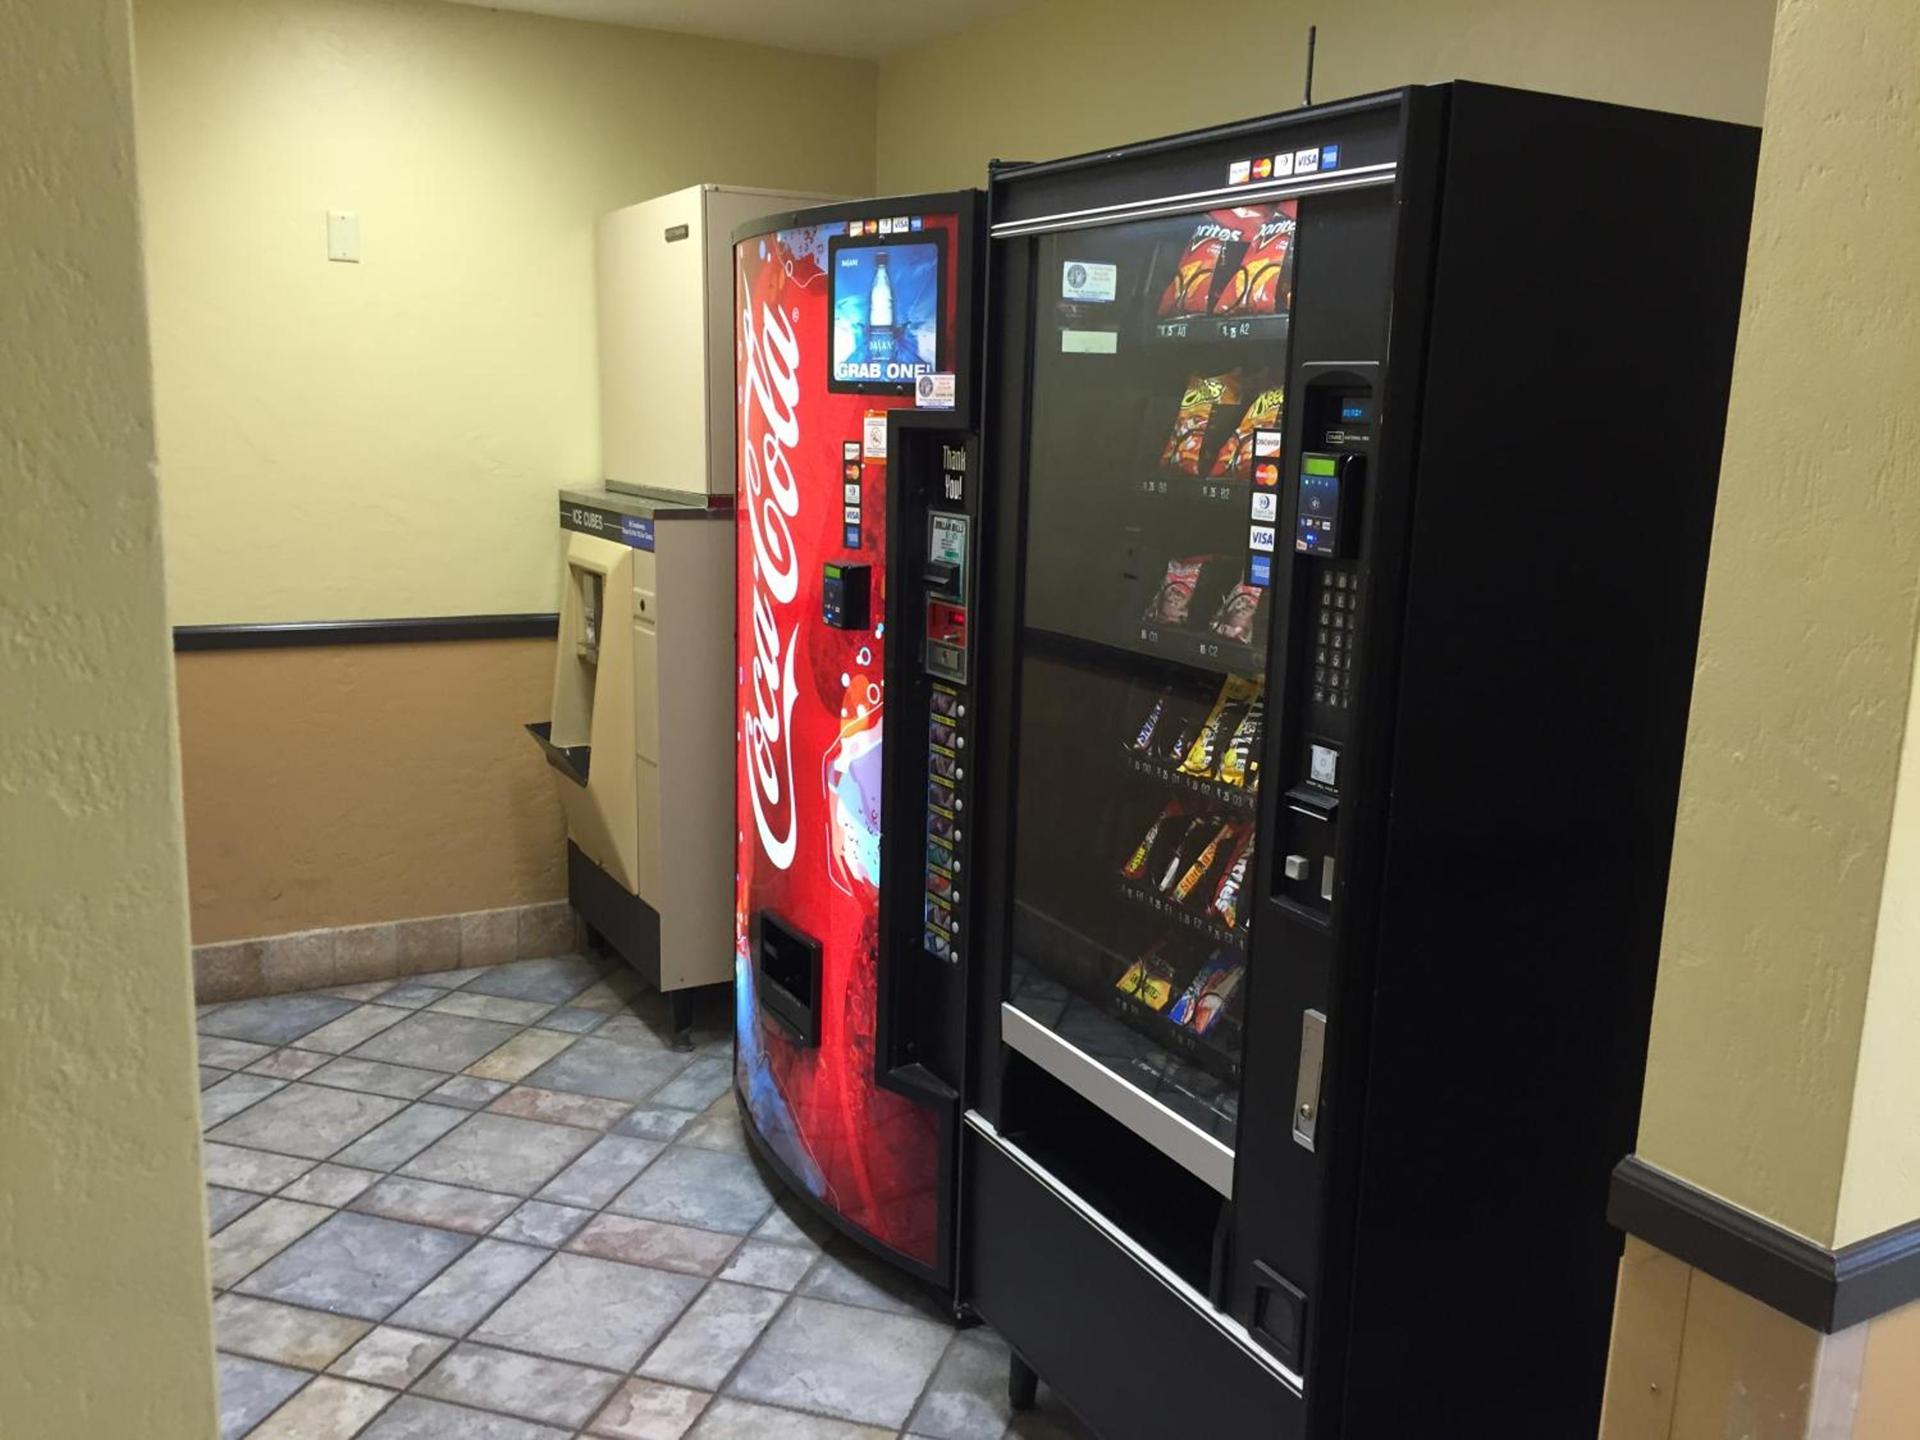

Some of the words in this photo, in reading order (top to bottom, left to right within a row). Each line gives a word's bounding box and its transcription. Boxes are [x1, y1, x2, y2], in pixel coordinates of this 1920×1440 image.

[1298, 153, 1317, 167] VISA
[839, 362, 882, 379] GRAB
[943, 445, 966, 472] Thank
[573, 510, 583, 525] ICE
[584, 511, 604, 531] CUBES
[1252, 531, 1273, 545] VISA
[743, 272, 801, 870] Coca-Cola
